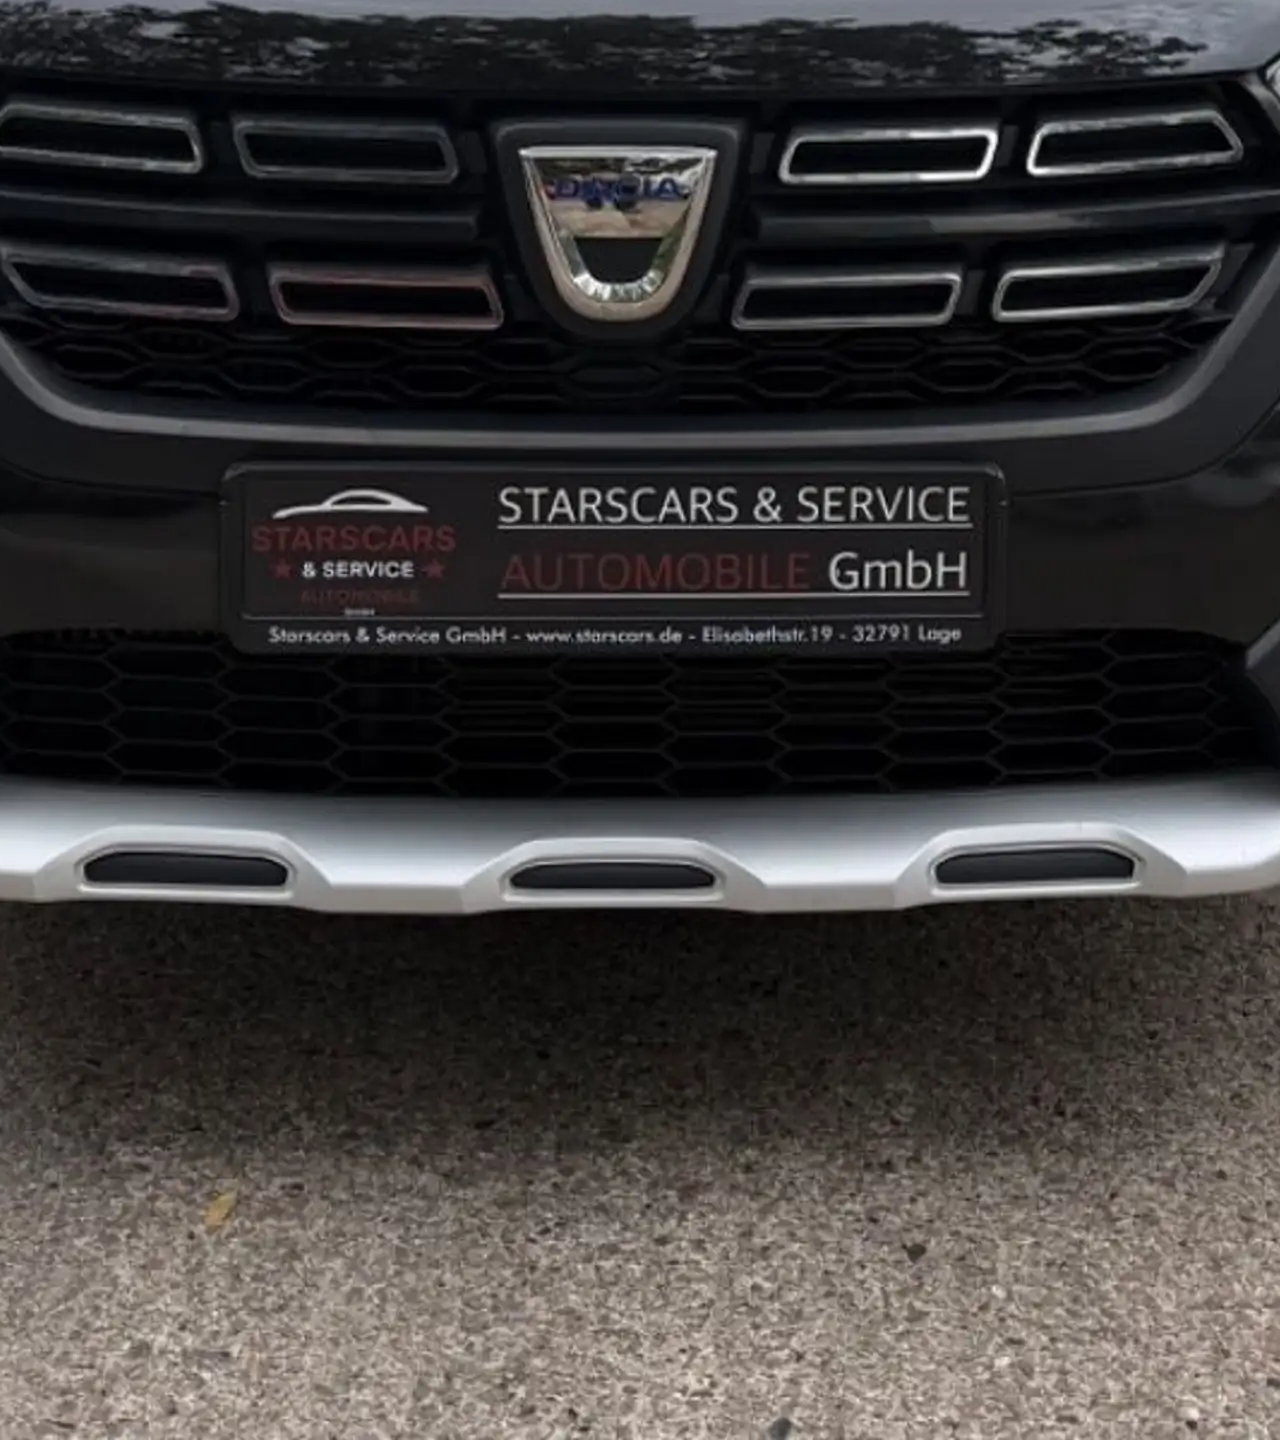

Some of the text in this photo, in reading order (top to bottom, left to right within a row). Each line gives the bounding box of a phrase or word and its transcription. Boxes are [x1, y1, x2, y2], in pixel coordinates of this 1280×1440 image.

[499, 486, 970, 523] STARSCARS & SERVICE
[251, 524, 458, 553] STARSCARS
[301, 561, 414, 578] & SERVICE
[500, 548, 967, 591] AUTOMOBILE GmbH
[268, 626, 351, 644] Starscars
[355, 626, 370, 643] &
[376, 626, 440, 644] Service
[445, 626, 507, 644] GmbH
[525, 625, 682, 644] www.starscars.de
[852, 624, 910, 642] 32791
[918, 624, 962, 646] Lage
